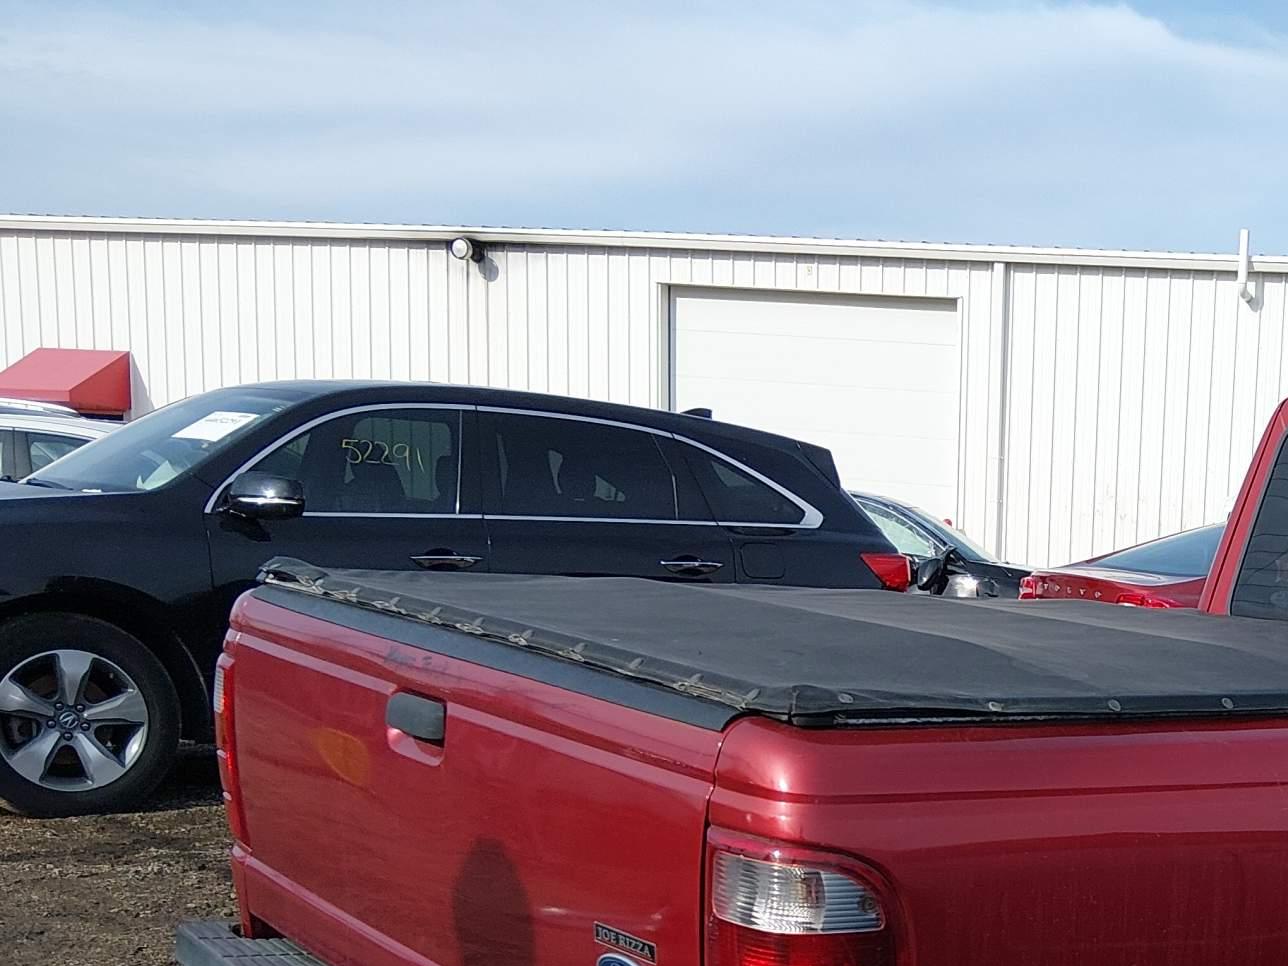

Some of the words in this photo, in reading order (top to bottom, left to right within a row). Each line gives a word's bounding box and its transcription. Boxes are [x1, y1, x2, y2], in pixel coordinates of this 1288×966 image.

[342, 439, 425, 472] 52291
[597, 926, 617, 943] JOE
[618, 936, 651, 958] RIZZA
